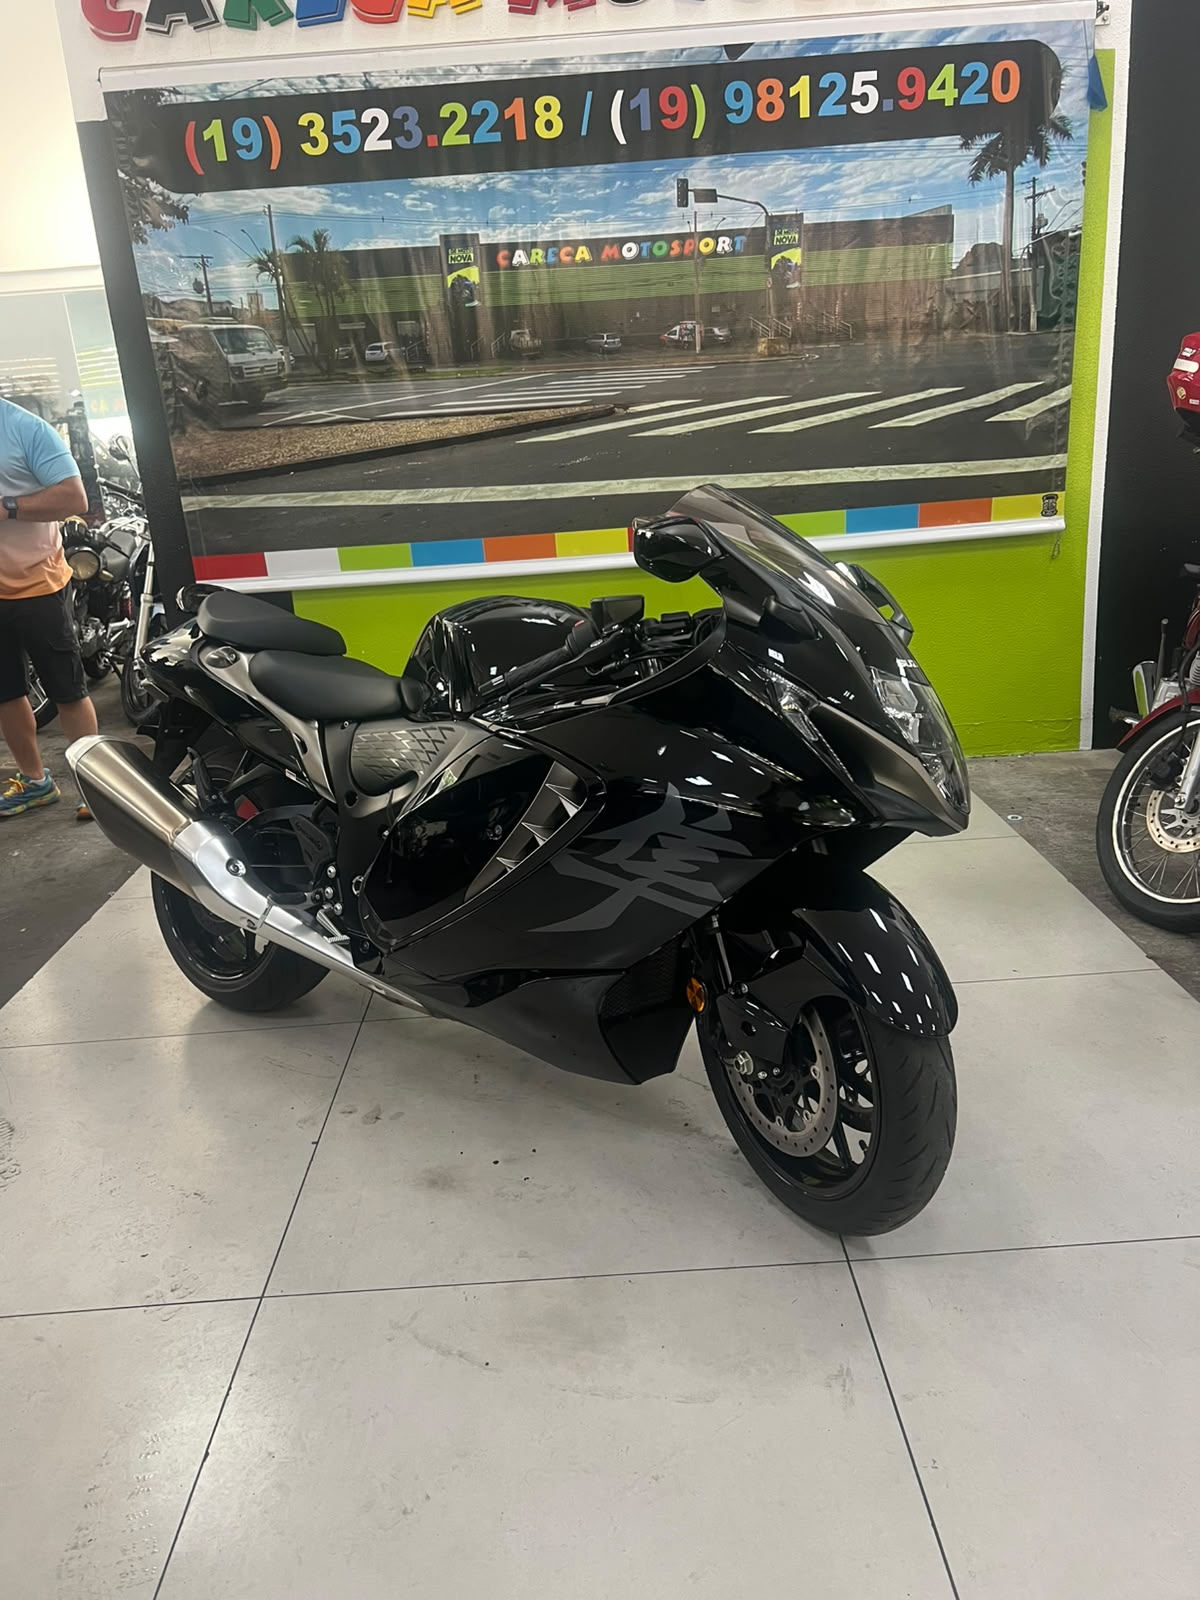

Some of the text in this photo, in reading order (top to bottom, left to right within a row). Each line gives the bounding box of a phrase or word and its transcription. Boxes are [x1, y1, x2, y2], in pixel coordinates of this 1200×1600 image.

[184, 115, 282, 175] (19)
[298, 95, 564, 157] 3523.2218
[610, 83, 706, 145] (19)
[724, 59, 1021, 126] 98125.9420
[449, 254, 473, 264] NOVA
[496, 235, 747, 268] CARECA MOTOSPORT
